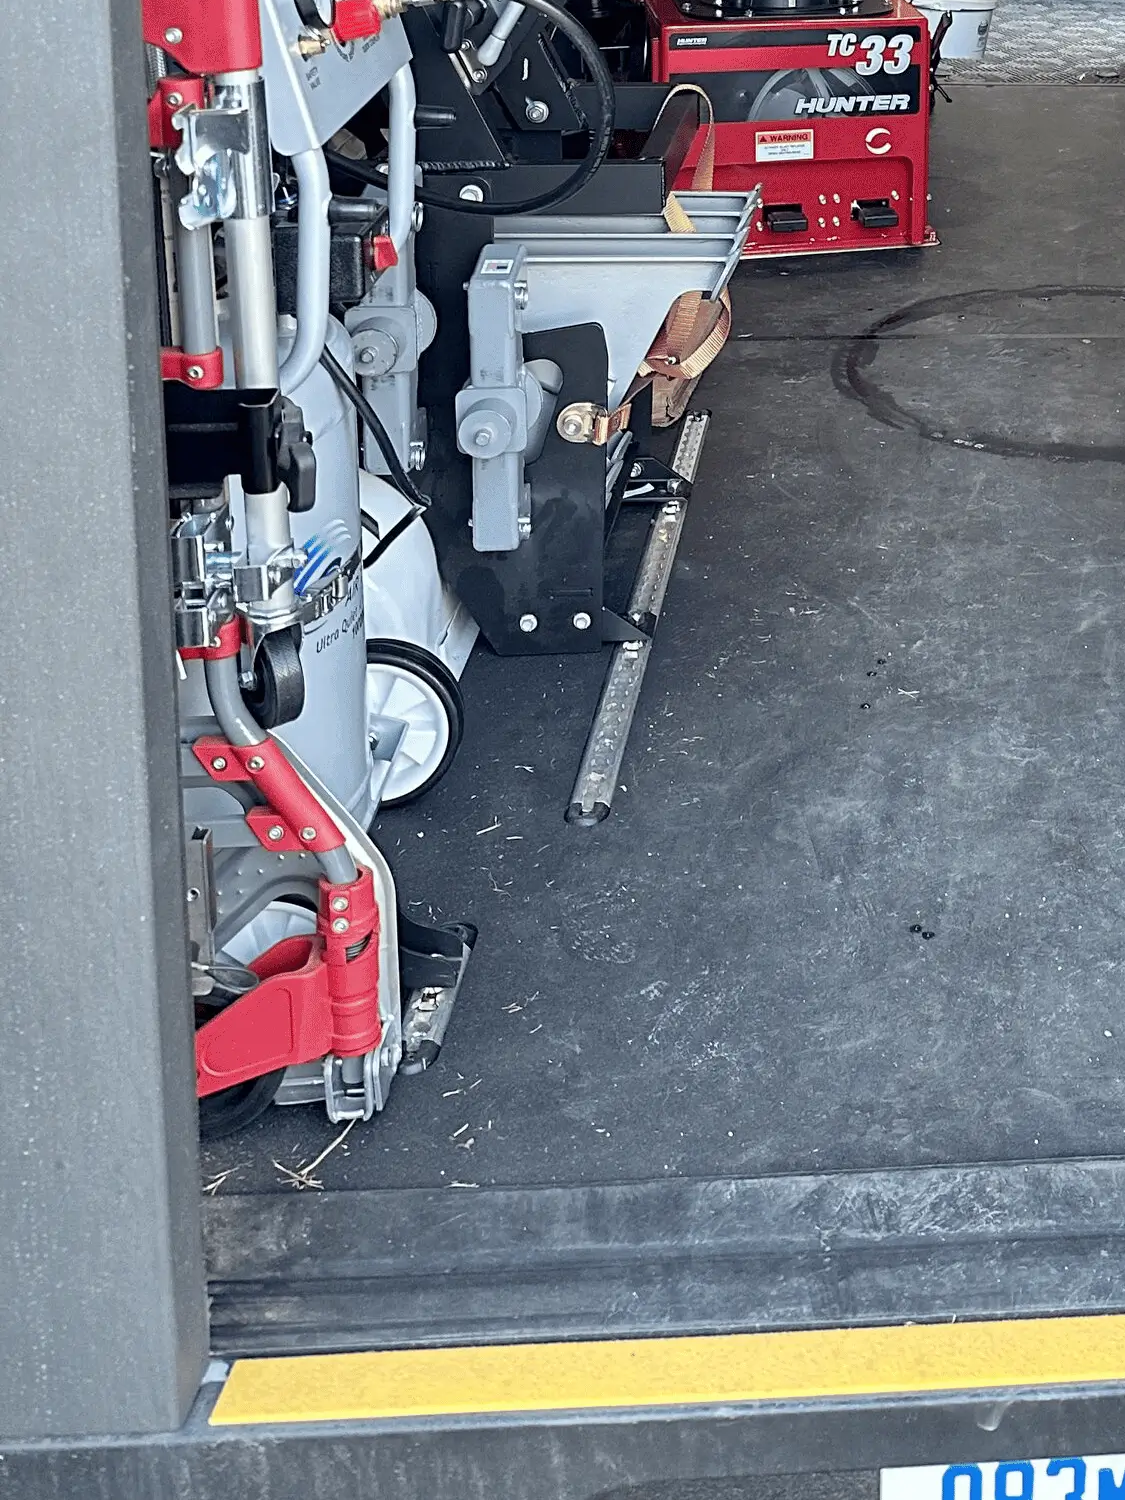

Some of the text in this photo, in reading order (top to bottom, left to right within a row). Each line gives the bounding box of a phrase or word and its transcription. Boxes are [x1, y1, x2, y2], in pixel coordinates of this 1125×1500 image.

[827, 33, 914, 76] TC 33
[794, 94, 911, 115] HUNTER
[770, 132, 809, 143] WARNING
